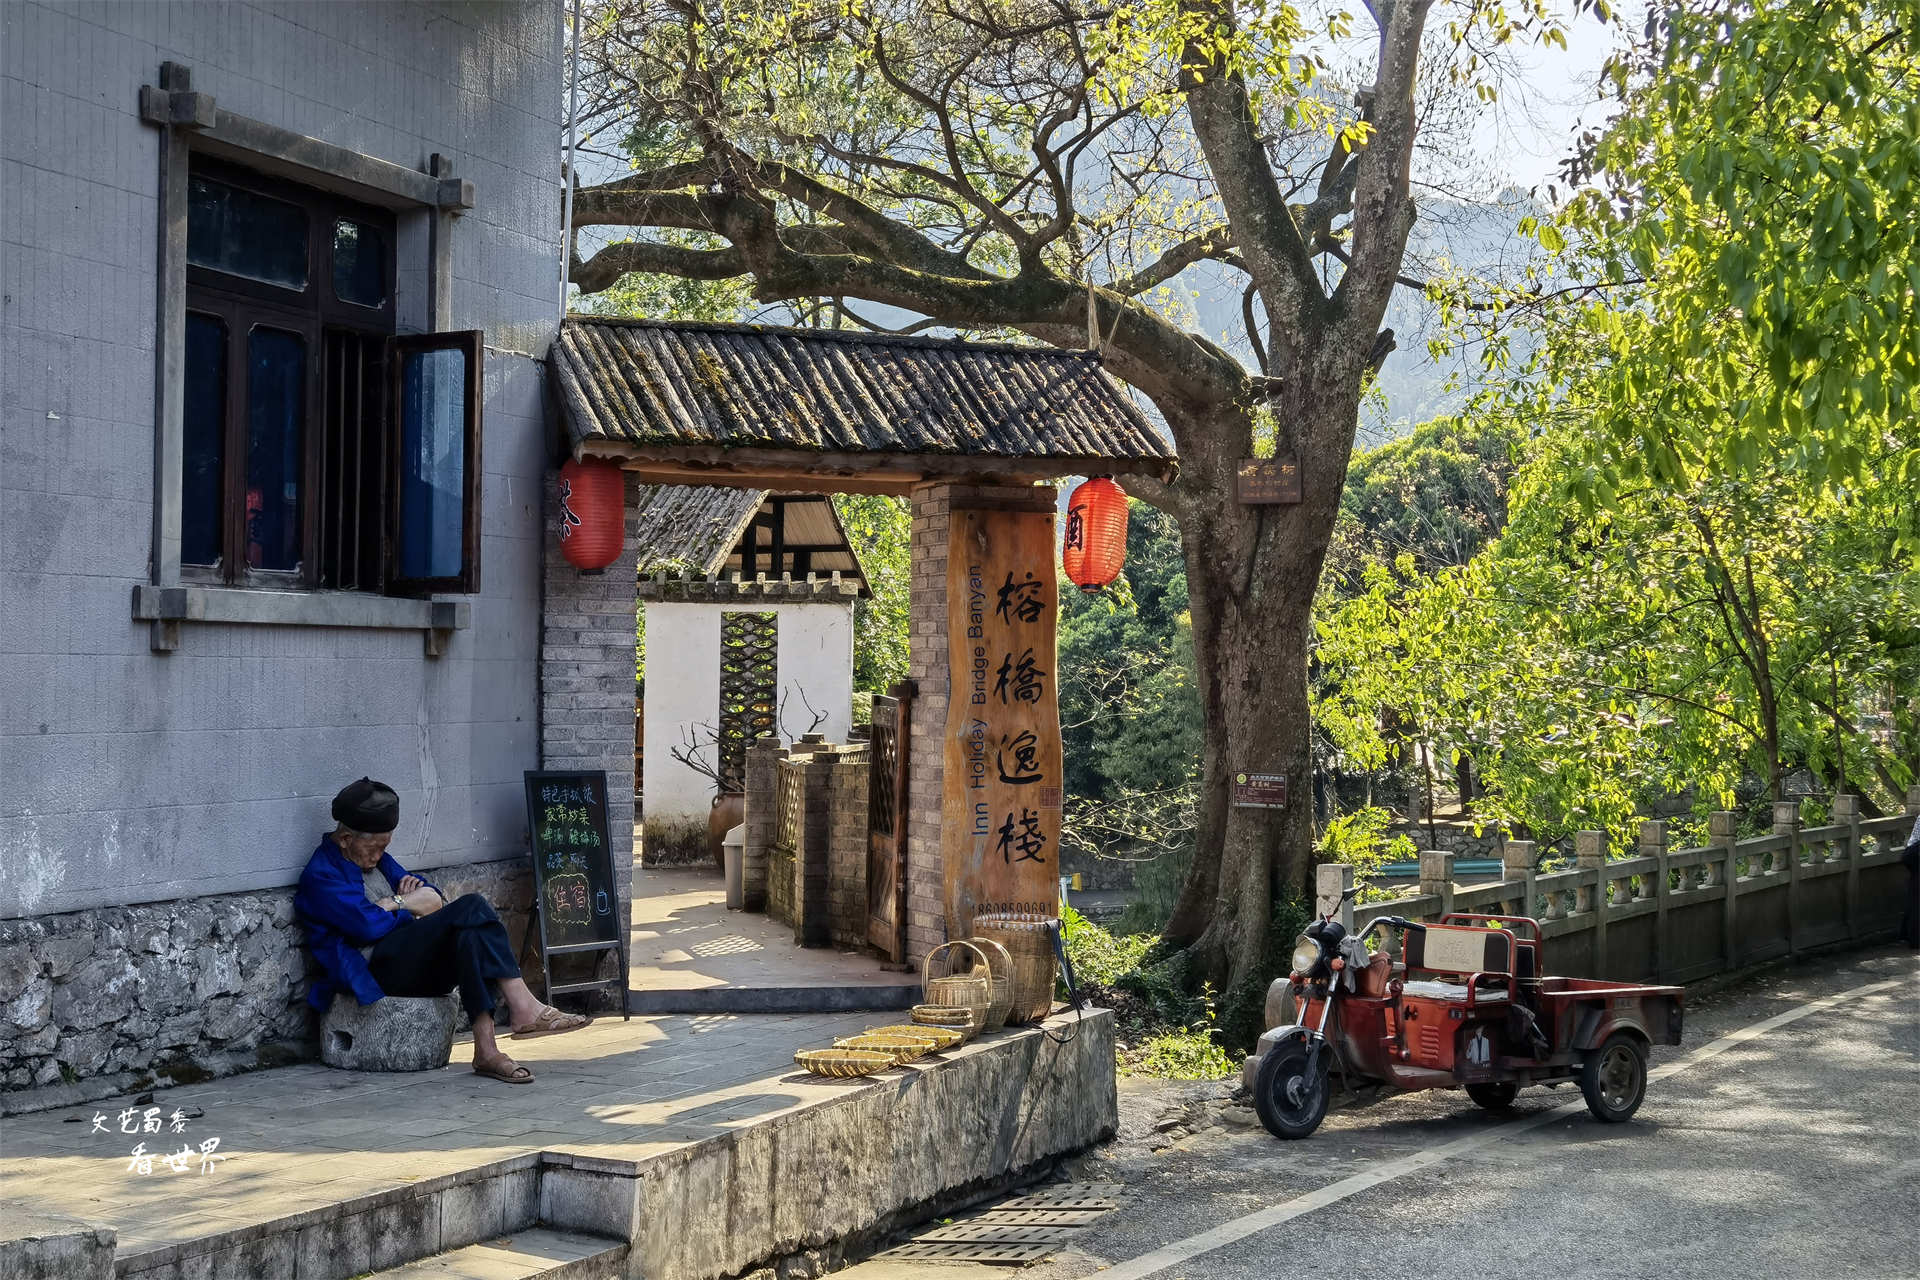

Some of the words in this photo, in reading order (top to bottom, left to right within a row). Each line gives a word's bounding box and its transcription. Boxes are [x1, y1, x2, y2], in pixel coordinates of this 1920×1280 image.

[968, 565, 984, 639] Banyan
[970, 646, 990, 705] Bridge
[970, 718, 989, 789] Holiday
[544, 803, 590, 825] 家常炒菜
[972, 802, 989, 836] Inn
[554, 880, 587, 912] 住宿
